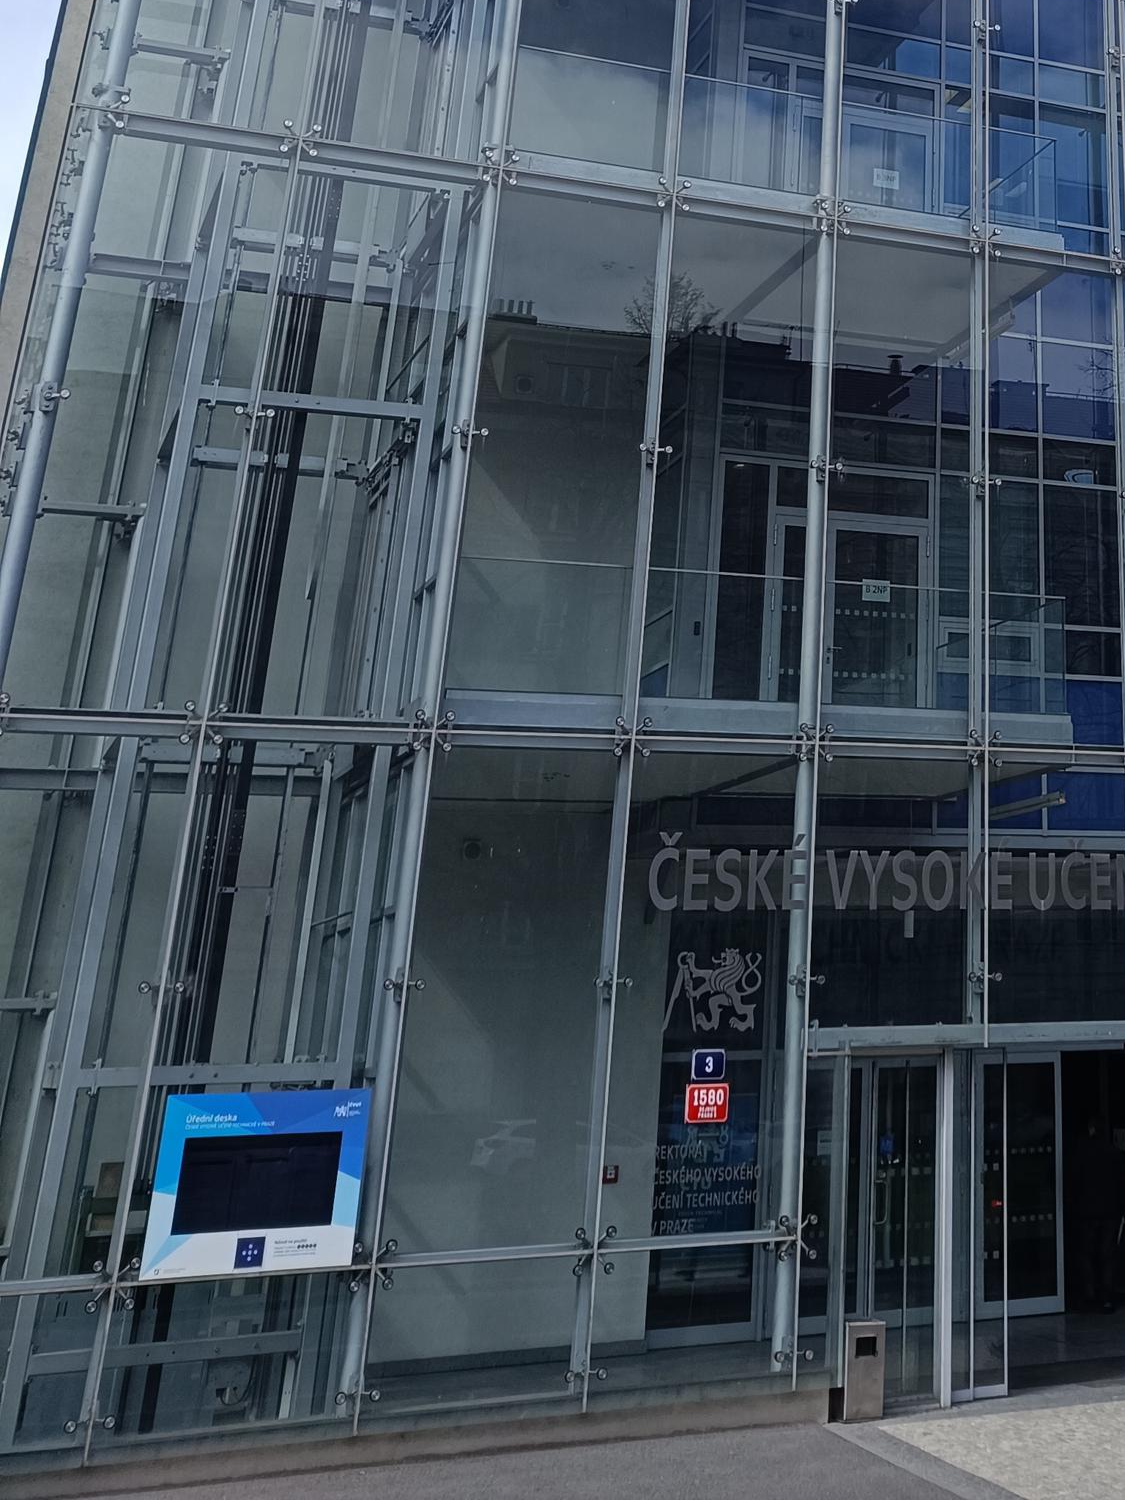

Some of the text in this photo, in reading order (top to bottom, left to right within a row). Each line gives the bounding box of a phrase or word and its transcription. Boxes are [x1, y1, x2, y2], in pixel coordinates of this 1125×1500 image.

[649, 832, 808, 912] ČESKÉ
[826, 837, 1012, 912] VYSOKÉ
[704, 1056, 714, 1073] 3
[693, 1089, 724, 1107] 1580
[704, 1161, 761, 1181] VYSOKÉHO
[686, 1187, 759, 1208] TECHNICKÉHO
[659, 1219, 694, 1235] PRAZE
